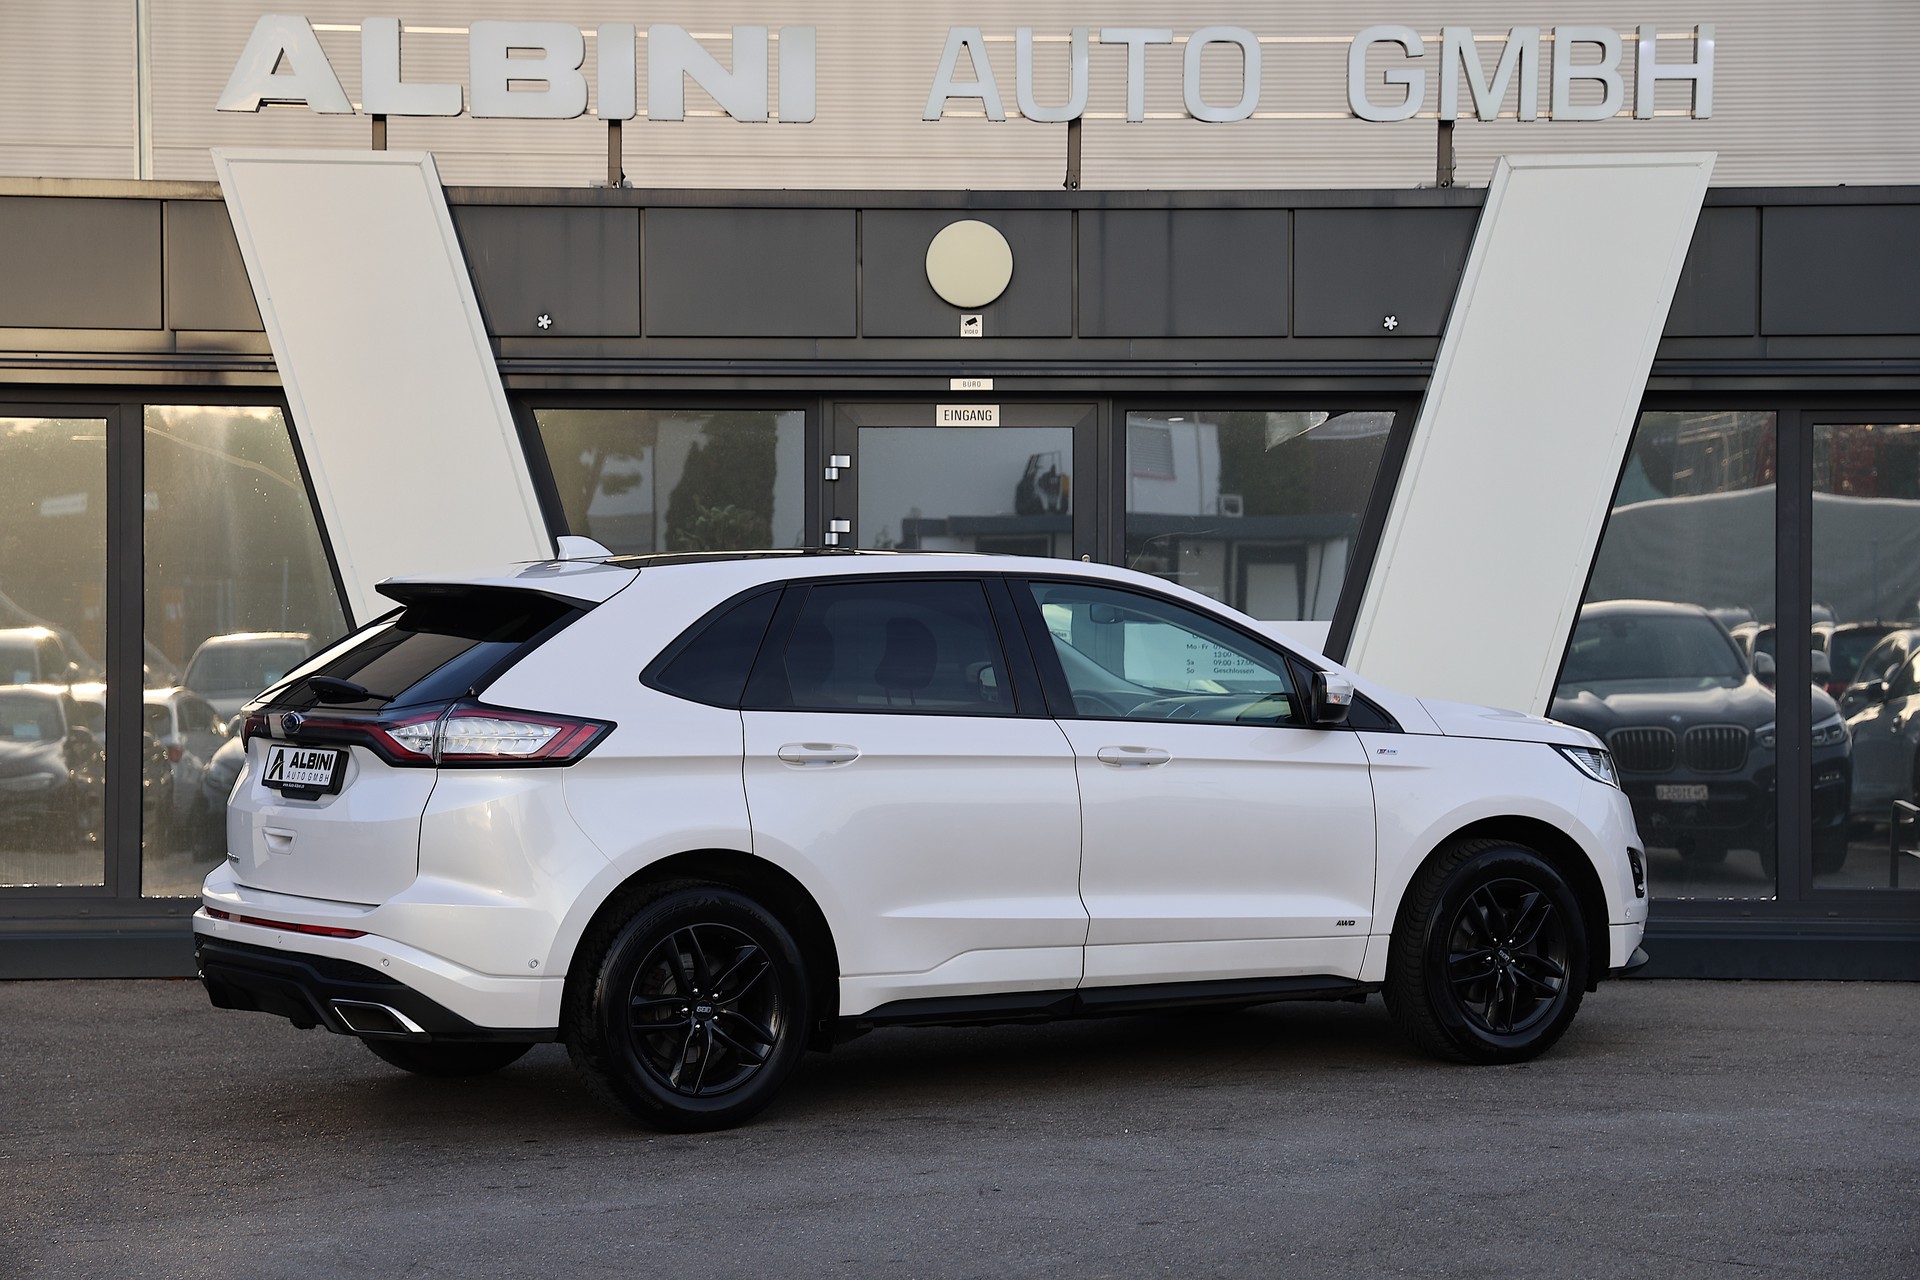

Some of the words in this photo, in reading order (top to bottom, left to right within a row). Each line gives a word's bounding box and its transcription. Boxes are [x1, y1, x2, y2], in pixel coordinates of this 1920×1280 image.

[216, 14, 817, 123] ALBINI
[922, 25, 1262, 123] AUTO
[1346, 24, 1715, 123] GMBH
[962, 380, 982, 388] BÜRO
[944, 409, 992, 421] EINGANG
[289, 751, 334, 771] ALBINI
[286, 771, 306, 781] AUTO
[307, 772, 330, 782] GMBH
[1336, 919, 1356, 927] AWD
